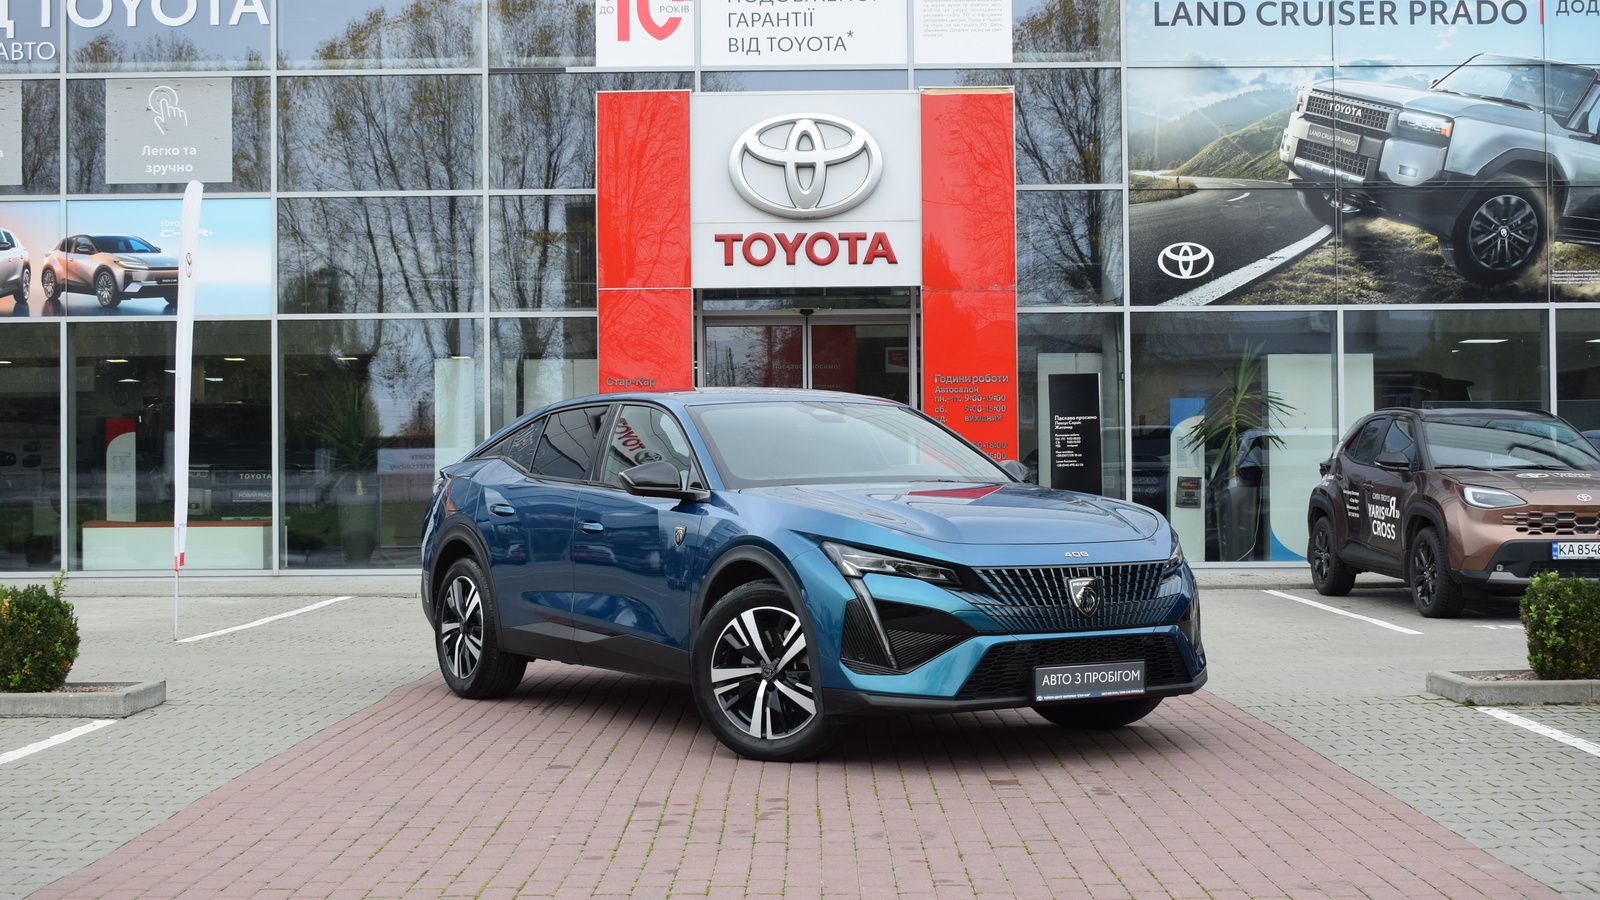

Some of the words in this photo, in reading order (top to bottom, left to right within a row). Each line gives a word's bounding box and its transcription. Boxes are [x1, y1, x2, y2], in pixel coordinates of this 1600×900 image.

[598, 5, 615, 15] ДО
[659, 5, 690, 14] РОКІВ
[1154, 1, 1246, 27] LAND
[1256, 0, 1399, 26] CRUISER
[1409, 0, 1528, 25] PRADO
[727, 8, 815, 28] ГАРАНТІЇ
[727, 36, 761, 56] ВІД
[1329, 102, 1362, 118] TOYOTA
[141, 145, 180, 156] Легко
[182, 146, 197, 156] та
[145, 163, 194, 176] зручно
[714, 231, 898, 267] TOYOTA
[605, 376, 657, 388] Стар-Кар
[934, 374, 971, 385] Години
[971, 373, 1009, 385] роботи
[934, 386, 979, 394] Автосалон
[964, 413, 1003, 422] вихідний
[1367, 503, 1386, 520] YARIS
[1372, 519, 1396, 540] CROSS
[1559, 544, 1575, 556] KA
[1041, 672, 1072, 687] АВТО
[1084, 669, 1141, 684] ПРОБІГОМ
